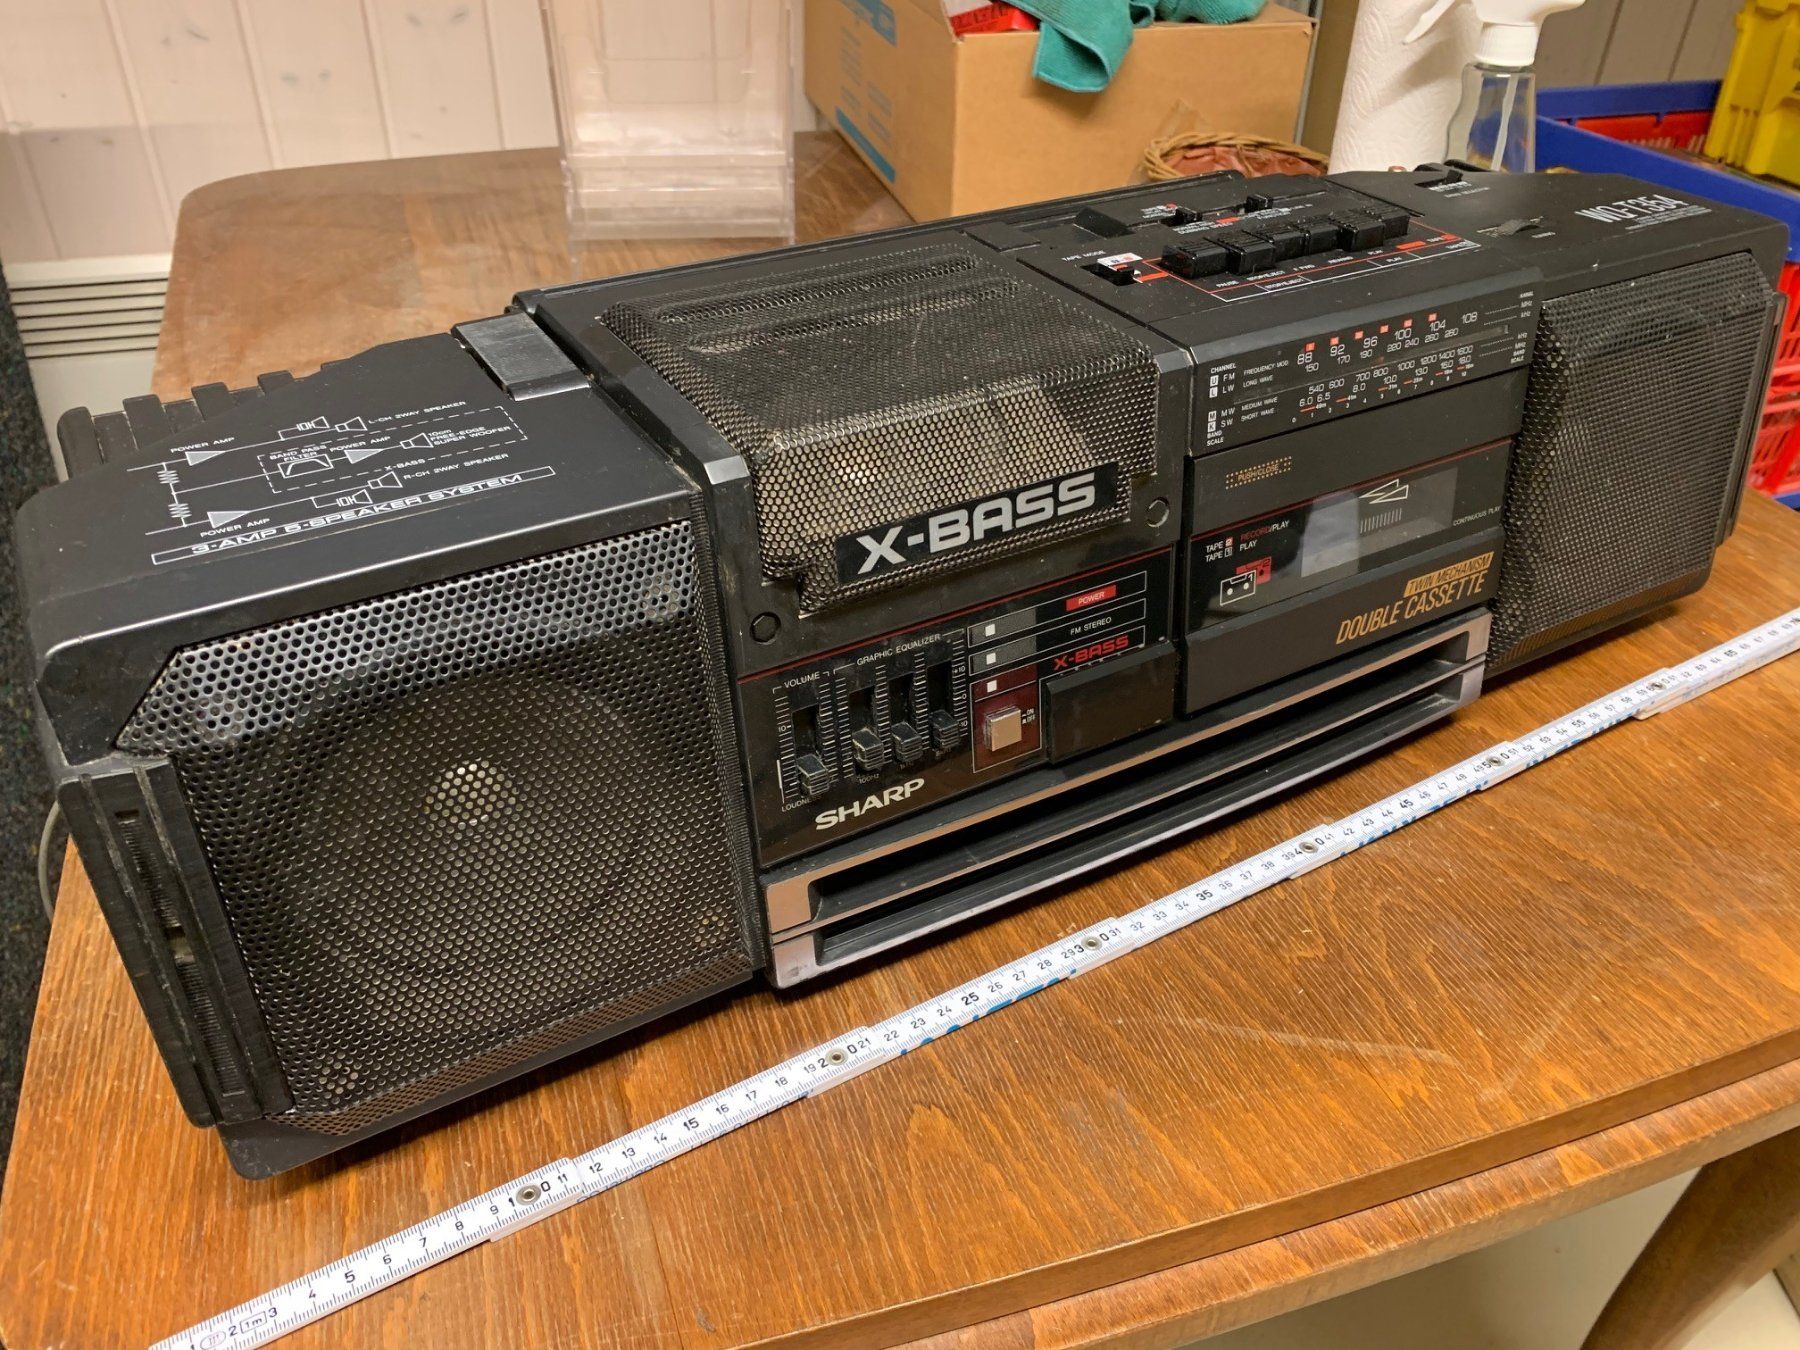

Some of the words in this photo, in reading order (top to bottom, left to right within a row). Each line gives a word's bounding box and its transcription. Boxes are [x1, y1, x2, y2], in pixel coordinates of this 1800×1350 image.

[1297, 352, 1313, 365] 88
[1330, 344, 1345, 357] 92
[1363, 336, 1378, 348] 96
[1394, 328, 1412, 340] 100
[1429, 320, 1446, 332] 104
[1461, 311, 1478, 324] 108
[1305, 362, 1319, 372] 150
[1337, 354, 1351, 365] 170
[1360, 349, 1373, 359] 190
[1386, 342, 1402, 353] 220
[1404, 337, 1420, 348] 240
[1210, 362, 1237, 374] CHANNEL
[1243, 363, 1275, 376] FREQUENCY
[1308, 383, 1325, 394] 540
[1328, 378, 1345, 389] 600
[1355, 371, 1371, 382] 700
[1372, 367, 1389, 378] 800
[1397, 360, 1416, 371] 1000
[1420, 354, 1438, 366] 1200
[1438, 349, 1456, 361] 1400
[1223, 372, 1235, 382] FM
[1243, 379, 1258, 388] LONG
[1259, 374, 1274, 383] WAVE
[1222, 384, 1235, 394] LW
[1299, 396, 1314, 407] 6.0
[1316, 391, 1331, 402] 6.5
[1352, 382, 1366, 393] 8.0
[1383, 374, 1398, 385] 10.0
[1220, 407, 1236, 417] MW
[1241, 401, 1262, 411] MEDIUM
[1263, 396, 1278, 405] WAVE
[368, 415, 392, 424] L-CH
[395, 410, 420, 420] 2WAY
[423, 401, 467, 414] SPEAKER
[1241, 413, 1259, 422] SHORT
[1260, 407, 1275, 416] WAVE
[1220, 418, 1234, 428] SW
[430, 426, 486, 441] FREE-EDGE
[433, 434, 466, 446] SUPER
[469, 425, 512, 439] WOOFER
[1207, 430, 1222, 439] BAND
[1207, 436, 1225, 447] SCALE
[170, 442, 209, 454] POWER
[213, 437, 235, 445] AMP
[269, 450, 298, 460] BAND
[301, 445, 327, 454] PASS
[329, 441, 367, 453] POWER
[370, 436, 391, 444] AMP
[283, 451, 318, 462] FILTER
[384, 458, 426, 471] X-BASS
[403, 470, 431, 480] R-CH
[433, 464, 460, 474] 2WAY
[463, 453, 509, 467] SPEAKER
[1237, 463, 1279, 482] PUSH/CLOSE
[192, 528, 277, 554] 3-AMP
[284, 496, 423, 533] 5-SPEAKER
[428, 474, 523, 502] SYSTEM
[1452, 511, 1487, 527] CONTINUOUS
[1488, 505, 1500, 515] PLAY
[200, 524, 242, 538] POWER
[246, 517, 270, 528] AMP
[856, 472, 1096, 575] X-BASS
[1205, 540, 1224, 553] TAPE
[1240, 519, 1290, 542] RECORD/PLAY
[1205, 551, 1223, 563] TAPE
[1239, 539, 1258, 552] PLAY
[1248, 573, 1254, 582] 1
[1440, 556, 1491, 582] MECHANISM
[1078, 591, 1105, 606] POWER
[1335, 600, 1403, 645] DOUBLE
[1404, 570, 1489, 619] CASSETTE
[1070, 626, 1082, 636] FM
[1083, 616, 1112, 632] STEREO
[856, 648, 893, 667] GRAPHIC
[895, 633, 941, 654] EQUALIZER
[1053, 633, 1129, 671] X-BASS
[784, 672, 821, 689] VOLUME
[1026, 708, 1035, 716] ON
[1026, 714, 1036, 723] OFF
[778, 725, 787, 733] 10
[814, 777, 925, 831] SHARP
[228, 1325, 238, 1337] 2
[244, 1318, 263, 1329] 1m
[268, 1307, 278, 1318] 3
[308, 1290, 317, 1299] 4
[344, 1269, 356, 1285] 5
[382, 1254, 392, 1266] 6
[419, 1237, 427, 1250] 7
[455, 1220, 464, 1232] 8
[490, 1204, 499, 1215] 9
[557, 1173, 569, 1184] 11
[588, 1162, 604, 1174] 12
[621, 1147, 636, 1159] 13
[653, 1132, 668, 1144] 14
[683, 1117, 700, 1131] 15
[715, 1103, 730, 1116] 16
[745, 1090, 758, 1102] 17
[775, 1076, 788, 1088] 18
[803, 1063, 817, 1075] 19
[857, 1037, 871, 1049] 21
[883, 1030, 900, 1042] 22
[910, 1017, 927, 1029] 23
[936, 1004, 953, 1017] 24
[961, 991, 980, 1006] 25
[987, 981, 1003, 993] 26
[1012, 969, 1027, 982] 27
[1037, 959, 1053, 970] 28
[1060, 948, 1076, 959] 29
[1109, 926, 1121, 938] 31
[1130, 920, 1145, 932] 32
[1152, 910, 1168, 921] 33
[1174, 899, 1189, 911] 34
[1195, 888, 1214, 902] 35
[1218, 880, 1233, 891] 36
[1239, 870, 1253, 881] 37
[1260, 860, 1275, 871] 38
[1281, 851, 1296, 862] 39
[1324, 833, 1335, 842] 41
[1343, 827, 1355, 837] 42
[1362, 818, 1375, 828] 43
[1381, 809, 1394, 818] 44
[1399, 799, 1415, 810] 45
[1419, 790, 1432, 800] 46
[1437, 782, 1448, 791] 47
[1455, 773, 1468, 783] 48
